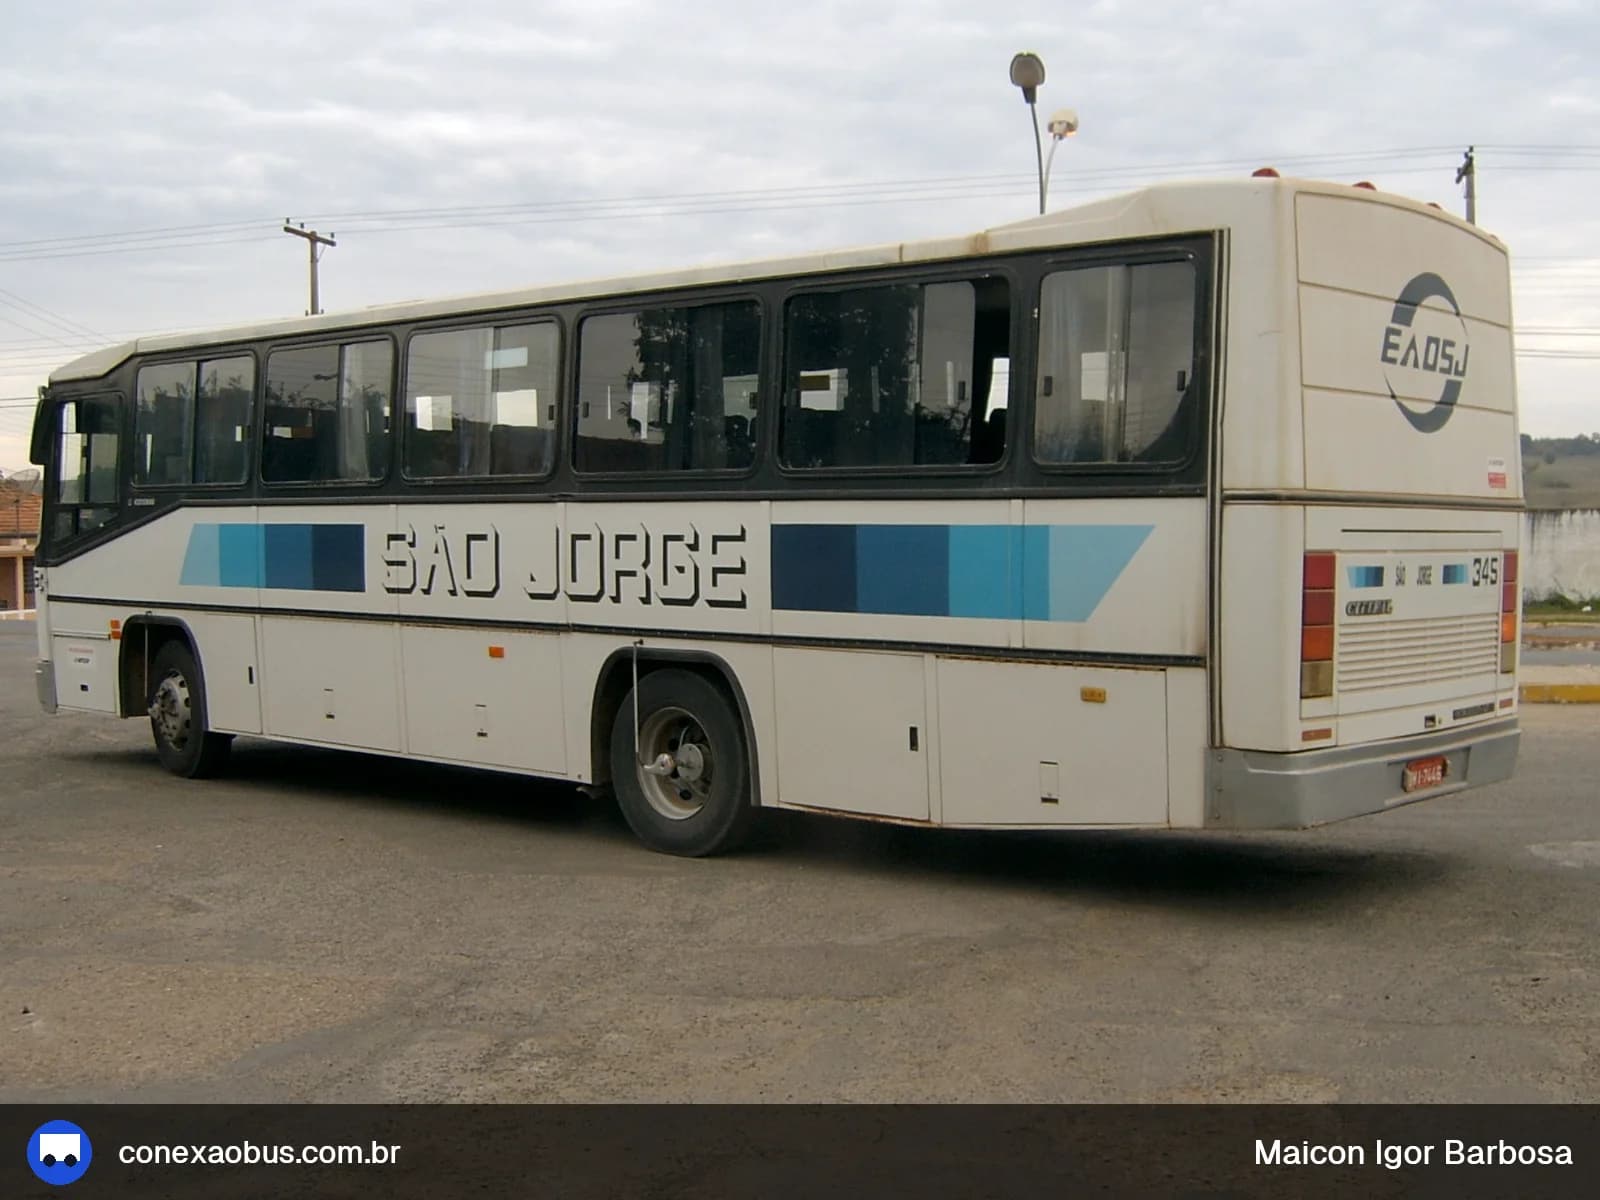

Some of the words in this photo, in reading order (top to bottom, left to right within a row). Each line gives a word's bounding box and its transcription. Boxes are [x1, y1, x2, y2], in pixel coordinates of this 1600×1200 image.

[380, 521, 500, 599] SÃO
[522, 520, 748, 609] JORGE
[1472, 557, 1498, 587] 345
